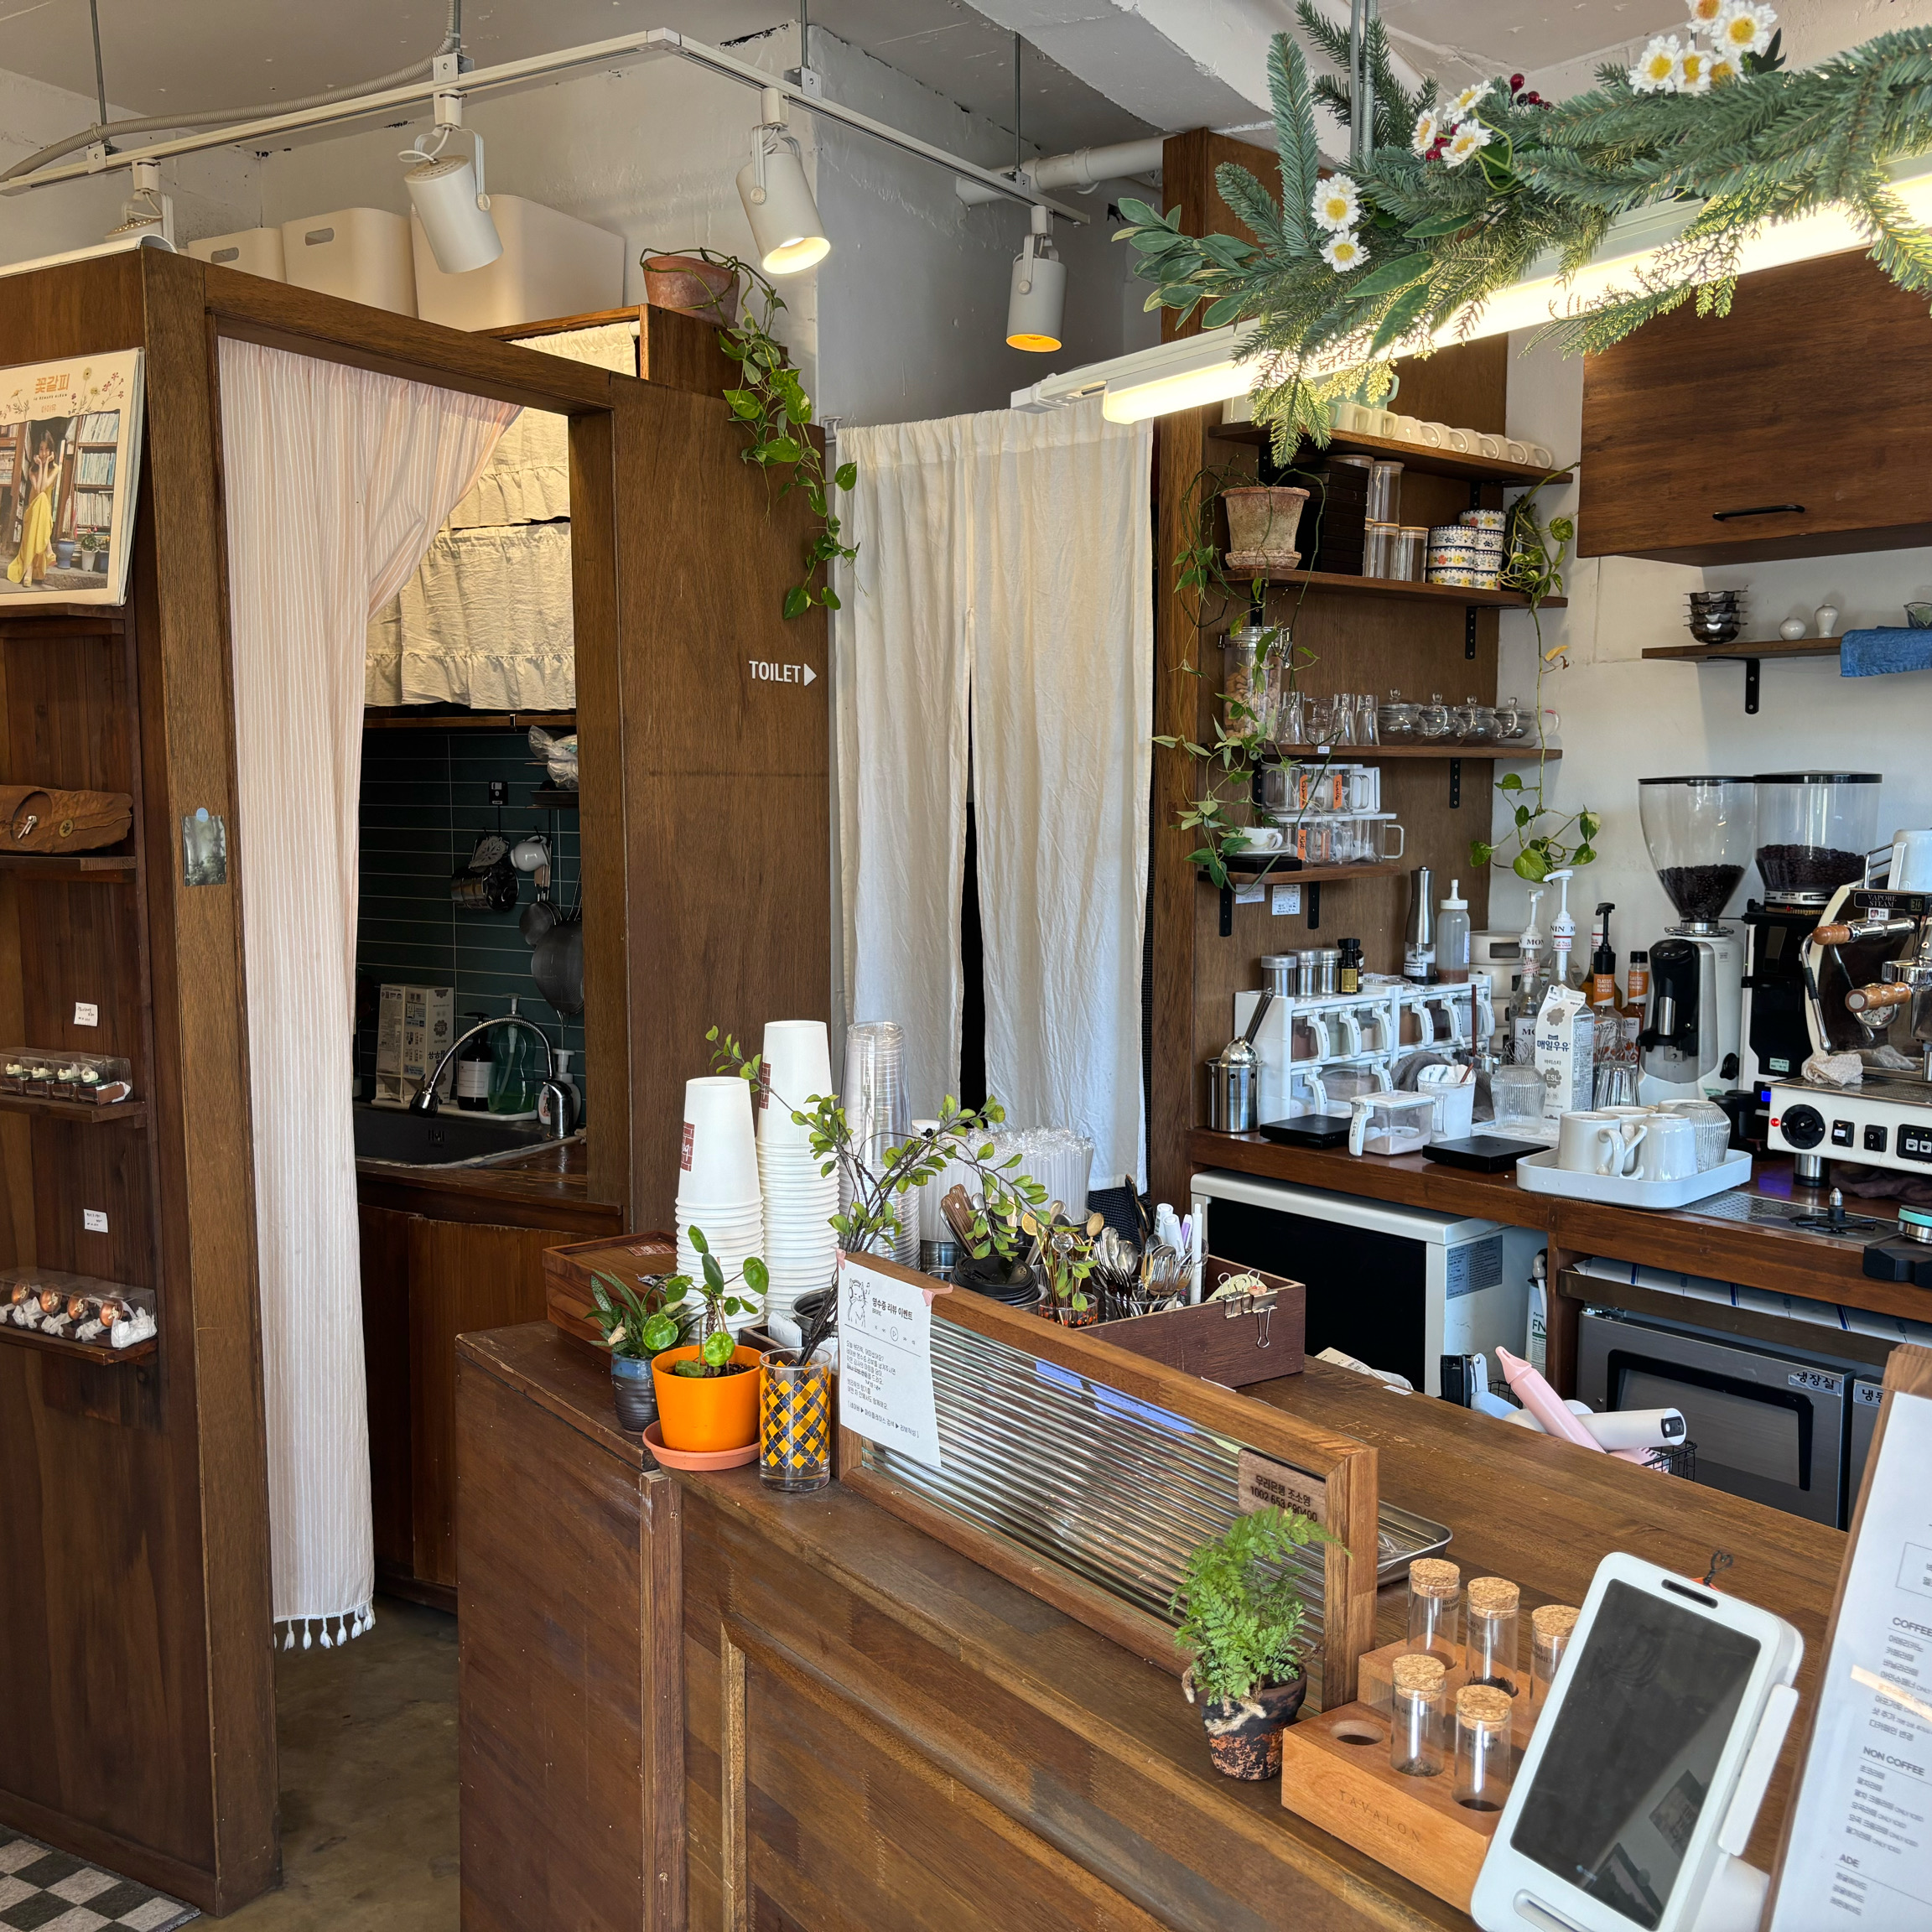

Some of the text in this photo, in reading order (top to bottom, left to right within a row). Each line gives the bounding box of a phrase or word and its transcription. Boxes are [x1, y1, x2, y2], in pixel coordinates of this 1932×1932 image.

[35, 373, 70, 394] 꽃갈피
[749, 660, 802, 683] TOILET
[1867, 894, 1898, 902] VAPORE
[1537, 1040, 1570, 1052] 매일우유
[872, 1297, 886, 1311] 영수증
[887, 1303, 897, 1315] 리뷰
[898, 1307, 913, 1321] 이벤트
[1797, 1371, 1835, 1390] 냉장실
[1249, 1486, 1270, 1502] 1002
[1270, 1494, 1285, 1509] 653
[1255, 1475, 1311, 1507] 우리은행 조소영
[1888, 1634, 1924, 1653] 아메리카노
[1886, 1646, 1914, 1662] 카페라떼
[1883, 1658, 1919, 1676] 바닐라라떼
[1863, 1746, 1925, 1777] NON COFFEE
[1839, 1853, 1861, 1868] ADE
